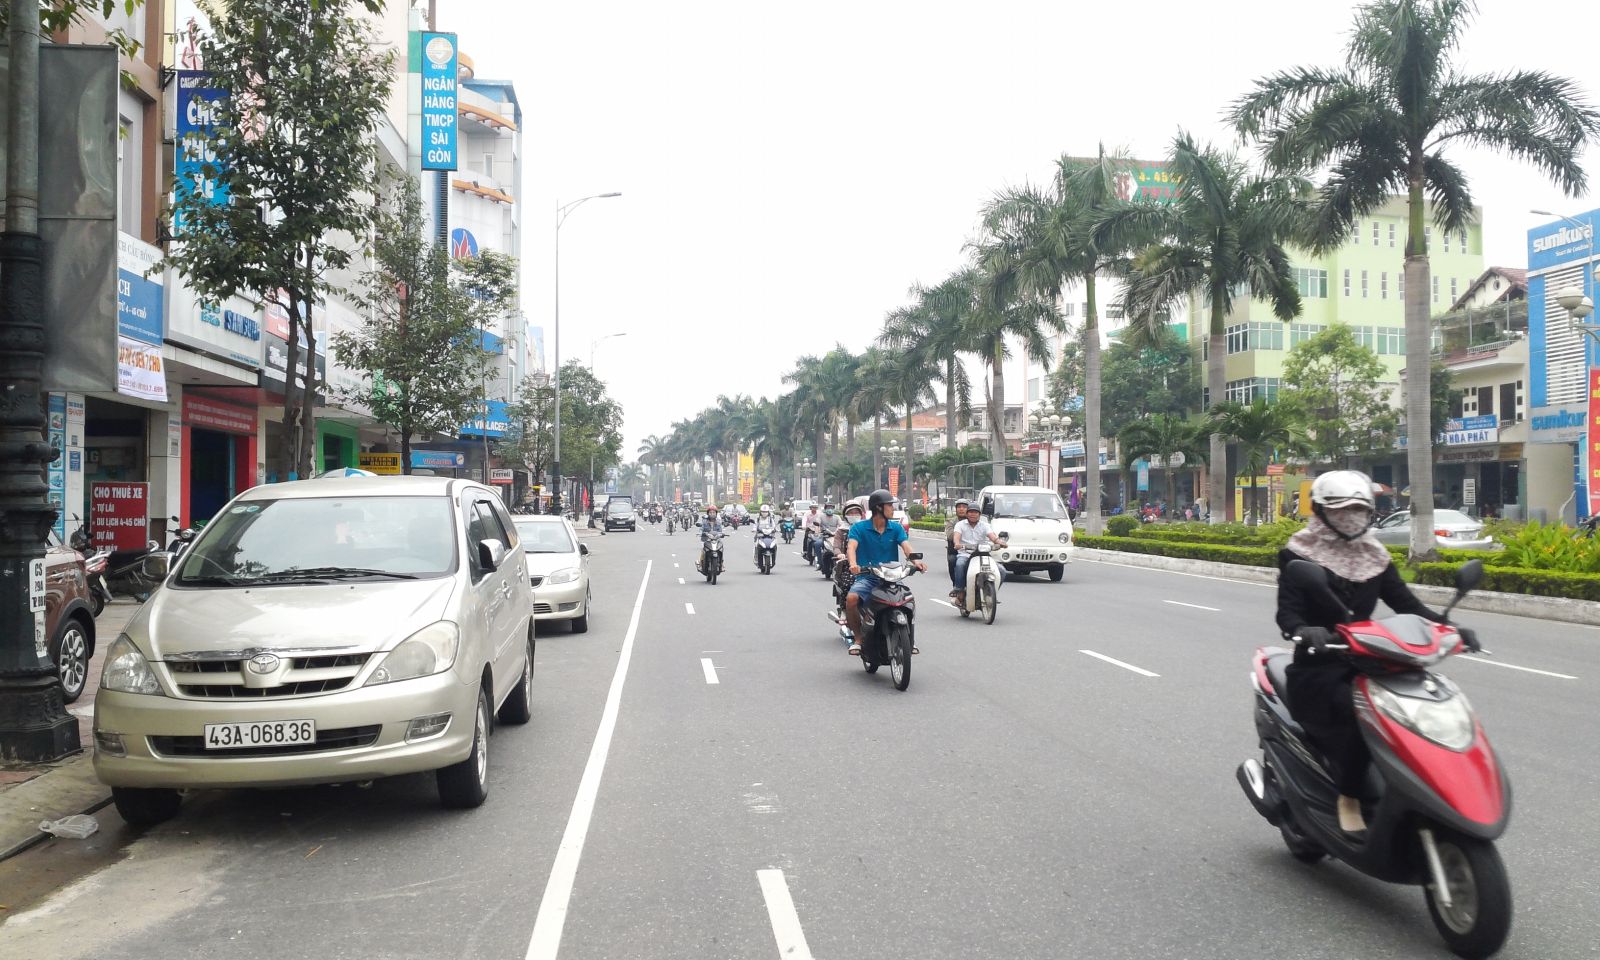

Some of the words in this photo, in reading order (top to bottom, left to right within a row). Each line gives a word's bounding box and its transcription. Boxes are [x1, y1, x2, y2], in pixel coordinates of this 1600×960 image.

[424, 75, 455, 91] NGÂN
[424, 93, 455, 109] HÀNG
[425, 114, 454, 127] TMCP
[431, 129, 449, 145] SÀI
[427, 147, 451, 163] GÒN
[1533, 224, 1593, 253] sumikura
[224, 309, 260, 341] SAMSUNG
[94, 487, 110, 498] CHO
[133, 487, 143, 499] XE
[96, 517, 105, 526] DU
[34, 563, 43, 576] CS
[209, 722, 311, 746] 43A-068.36
